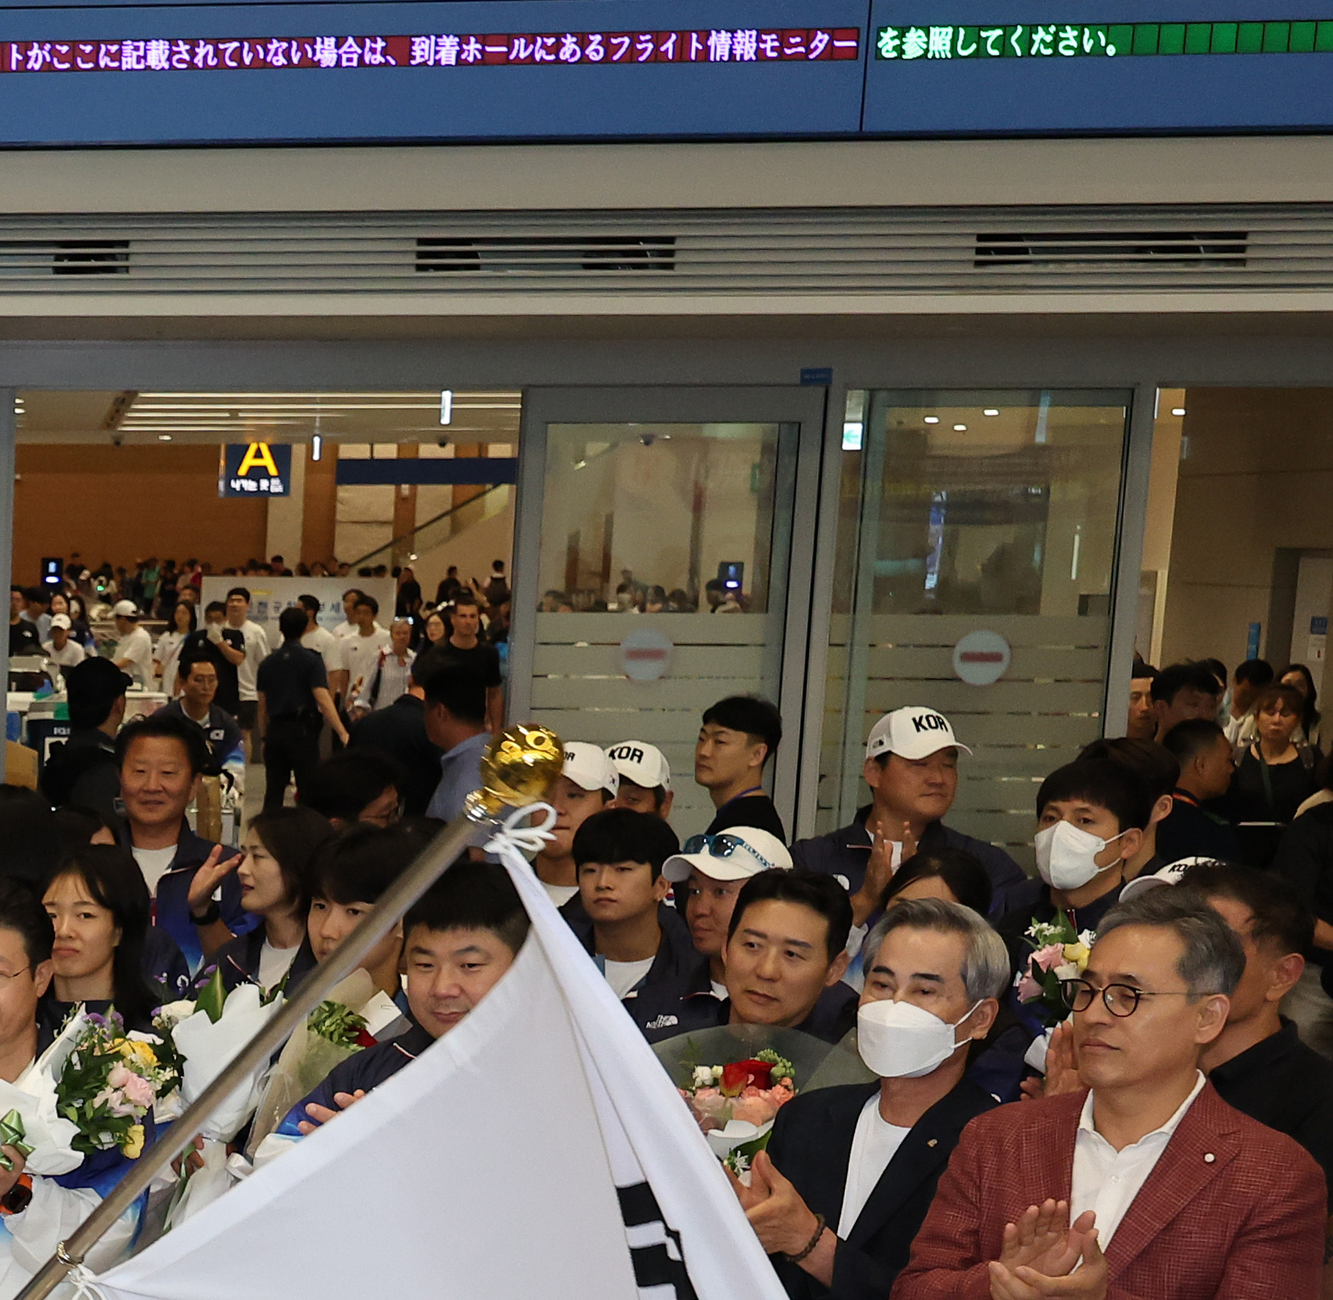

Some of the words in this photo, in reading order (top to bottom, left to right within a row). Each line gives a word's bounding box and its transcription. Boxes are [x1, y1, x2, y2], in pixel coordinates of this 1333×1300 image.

[877, 26, 1117, 60] を参照してください。
[237, 442, 279, 476] A
[911, 714, 949, 733] KOR
[563, 751, 576, 762] OR
[608, 746, 644, 764] KOR
